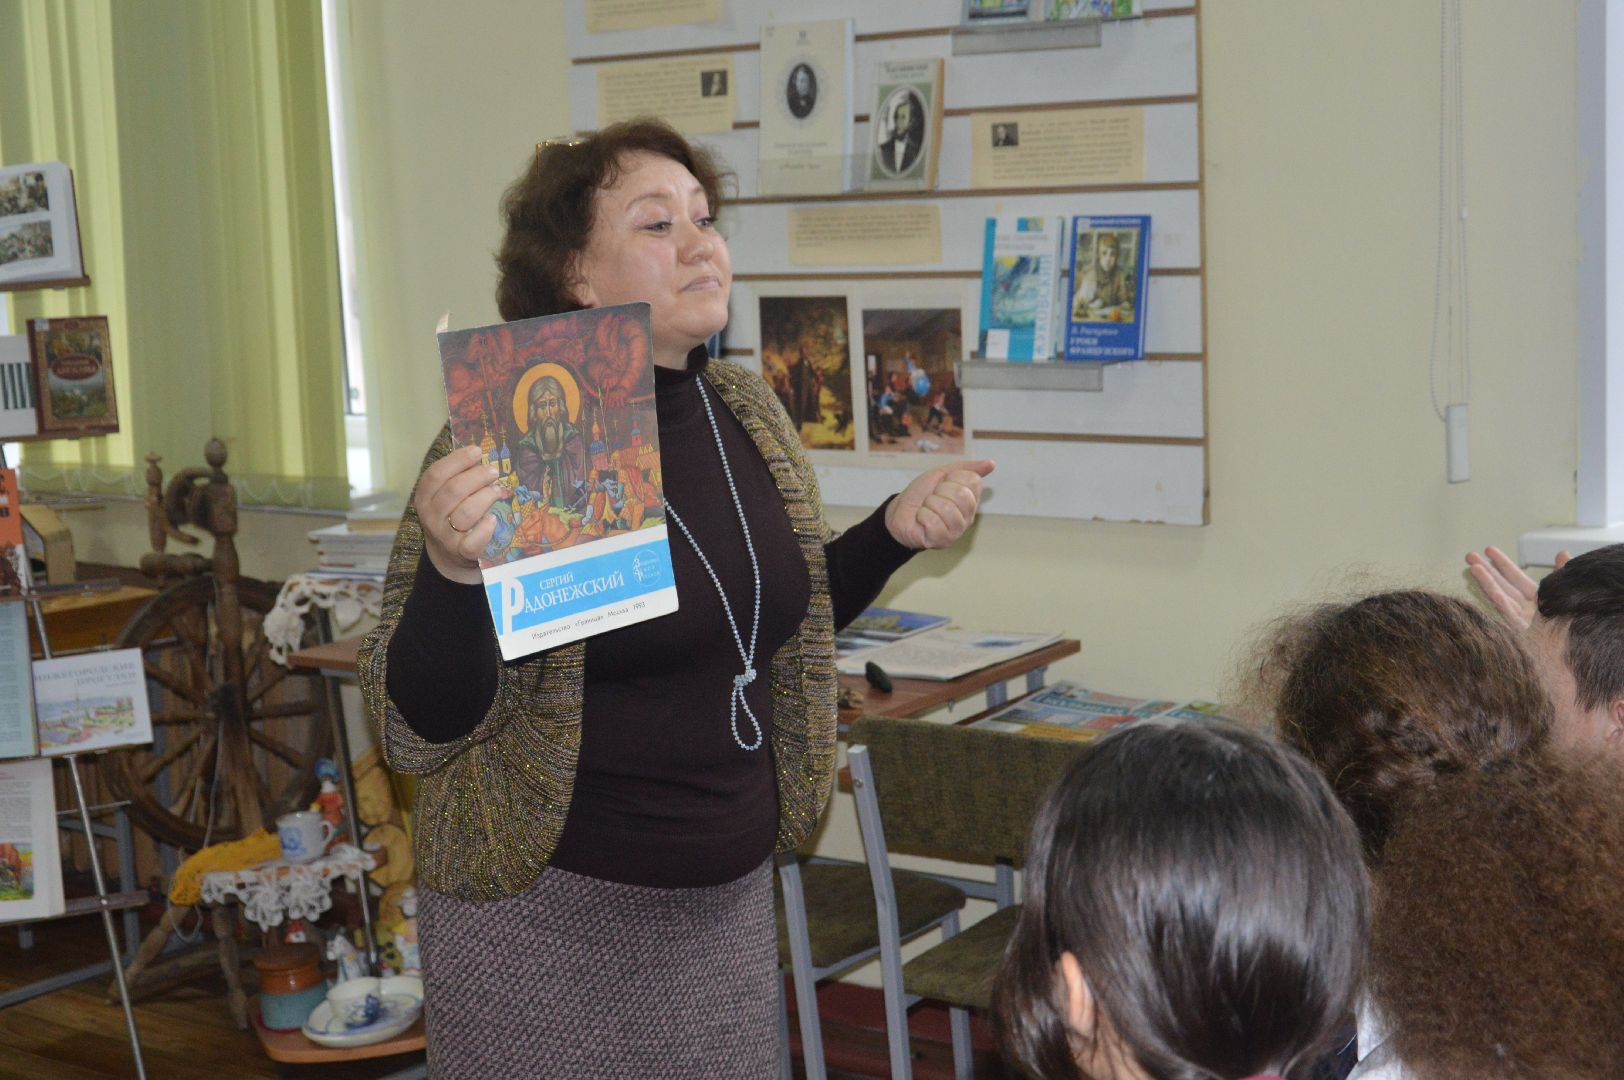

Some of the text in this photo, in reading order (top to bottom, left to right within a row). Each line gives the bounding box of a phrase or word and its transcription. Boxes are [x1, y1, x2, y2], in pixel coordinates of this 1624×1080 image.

[539, 571, 575, 590] СЕРГИЙ
[501, 571, 625, 635] РАДОНЕЖСКИЙ
[531, 624, 571, 639] Издательство
[607, 607, 629, 616] Москва
[633, 601, 646, 610] 1993
